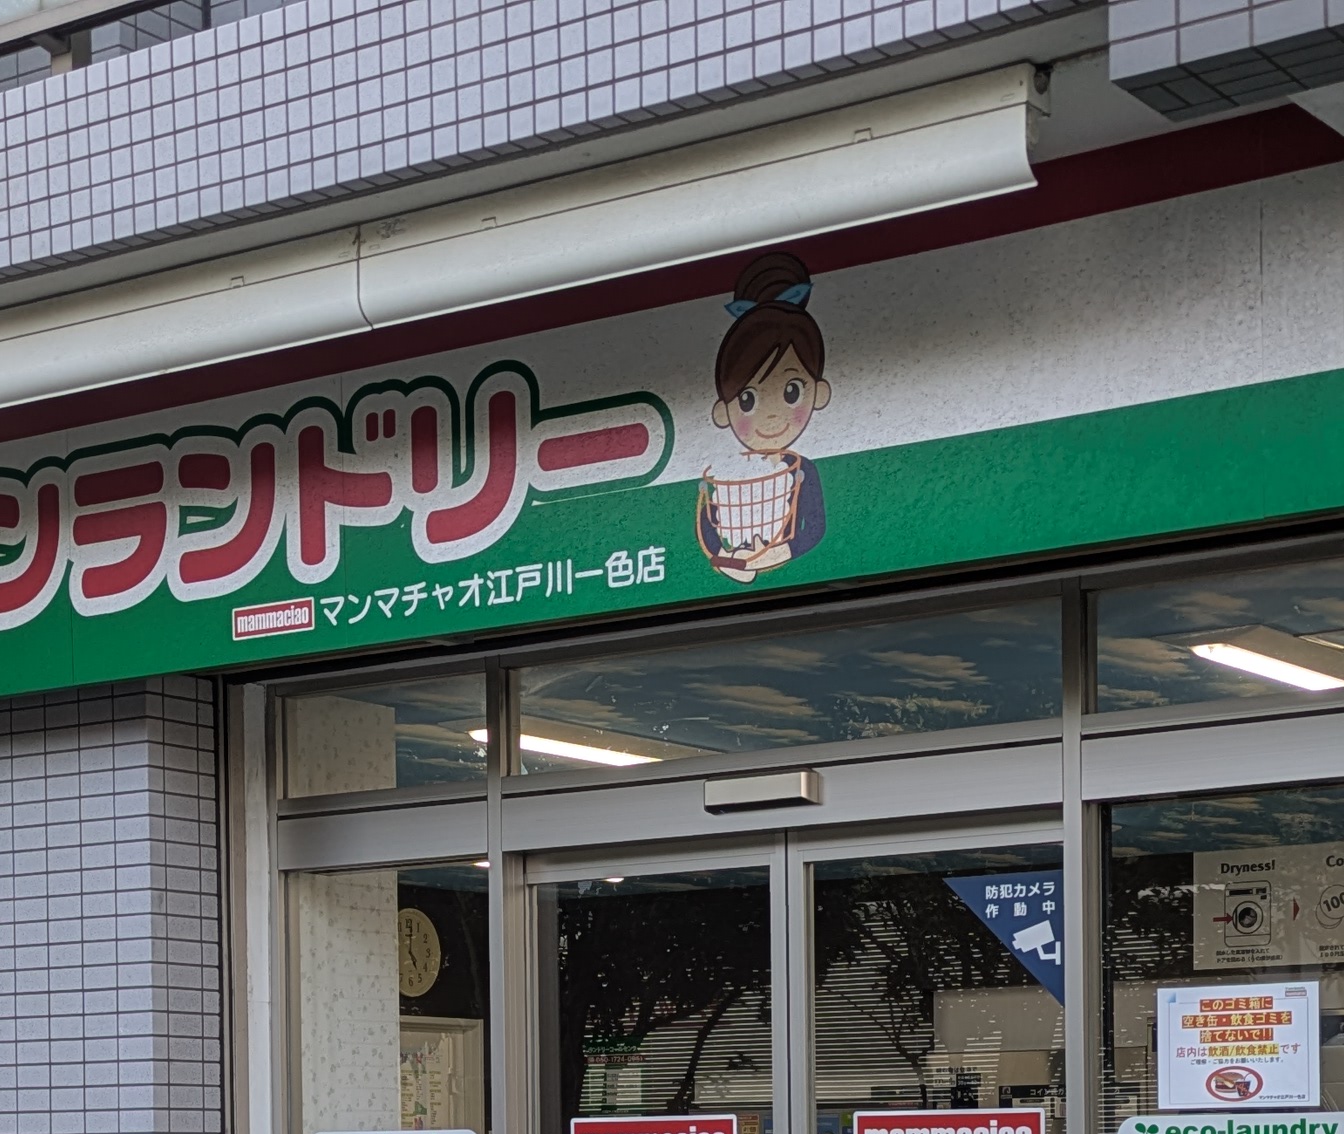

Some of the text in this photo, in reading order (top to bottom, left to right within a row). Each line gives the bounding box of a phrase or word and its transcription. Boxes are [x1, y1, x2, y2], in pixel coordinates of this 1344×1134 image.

[320, 546, 665, 625] マンマチャオ江戸川一色店
[237, 605, 310, 635] mammaciao
[1220, 860, 1276, 876] Dryness!
[985, 882, 1055, 899] 防犯カメラ
[985, 901, 1055, 918] 作動中
[1201, 997, 1272, 1011] このゴミ箱に
[1182, 1012, 1291, 1028] 空き缶・飲食ゴミを
[1201, 1028, 1273, 1042] 捨てないで!!
[1176, 1043, 1301, 1057] 店内は飲酒/飲食禁止です
